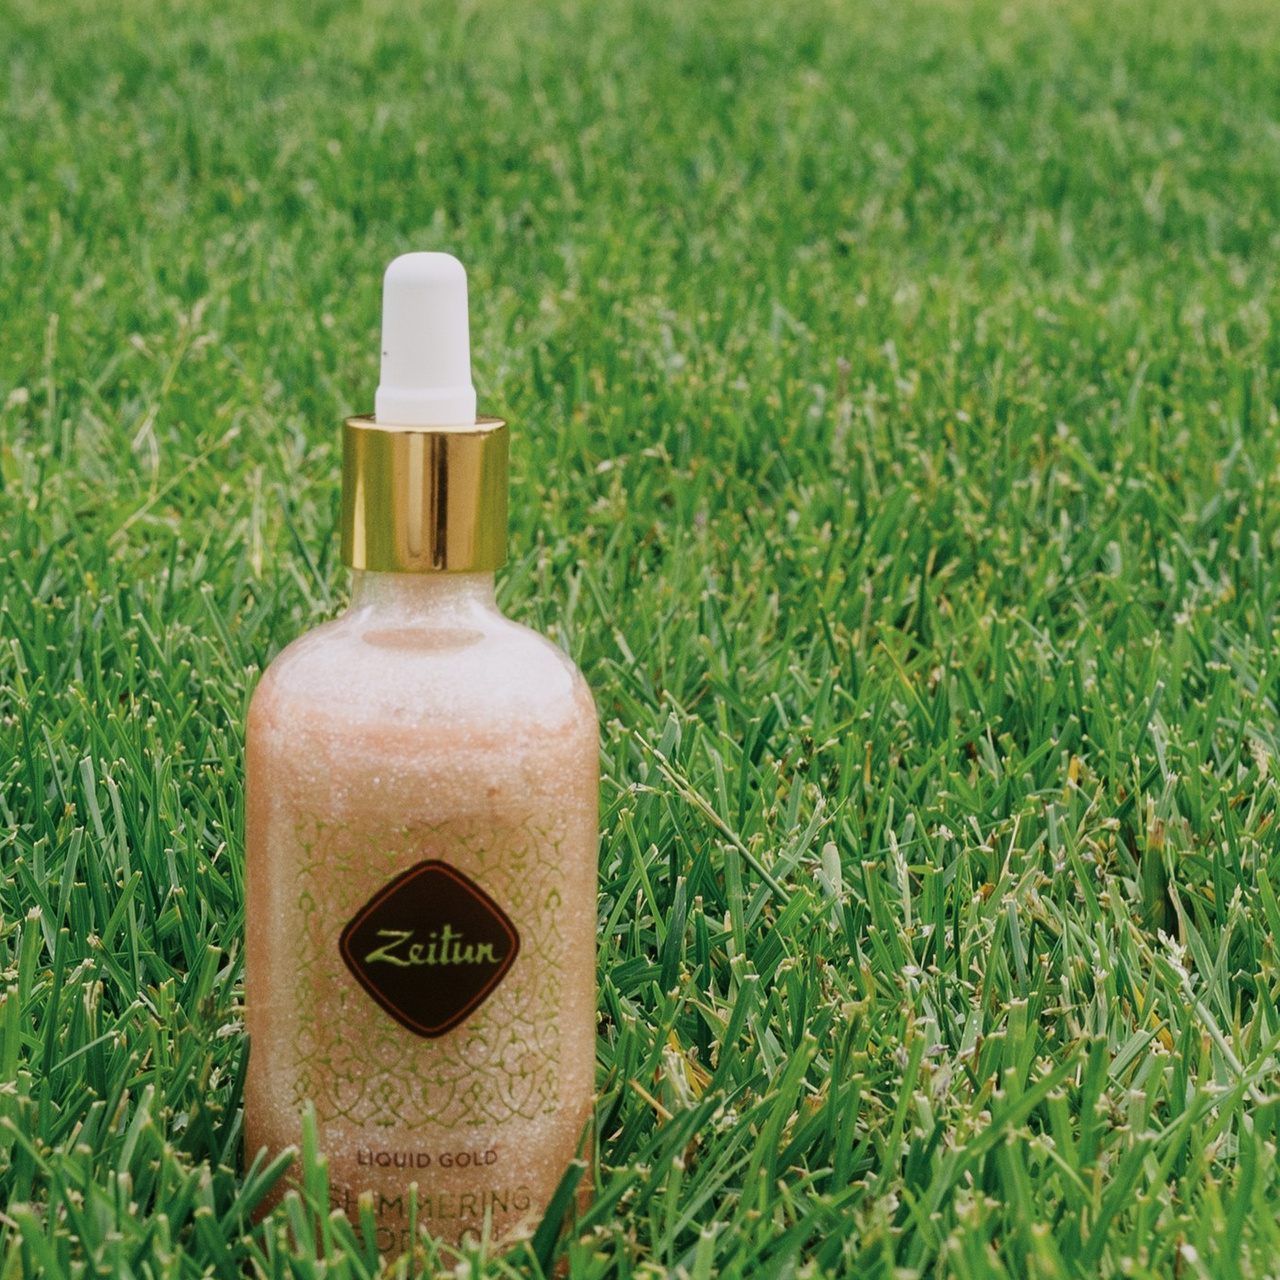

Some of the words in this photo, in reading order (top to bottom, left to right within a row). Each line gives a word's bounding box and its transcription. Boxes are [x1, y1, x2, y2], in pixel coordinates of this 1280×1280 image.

[365, 924, 502, 967] Zeitun
[357, 1150, 431, 1168] LIQUID
[439, 1150, 498, 1168] GOLD
[329, 1184, 531, 1218] SHMMERING
